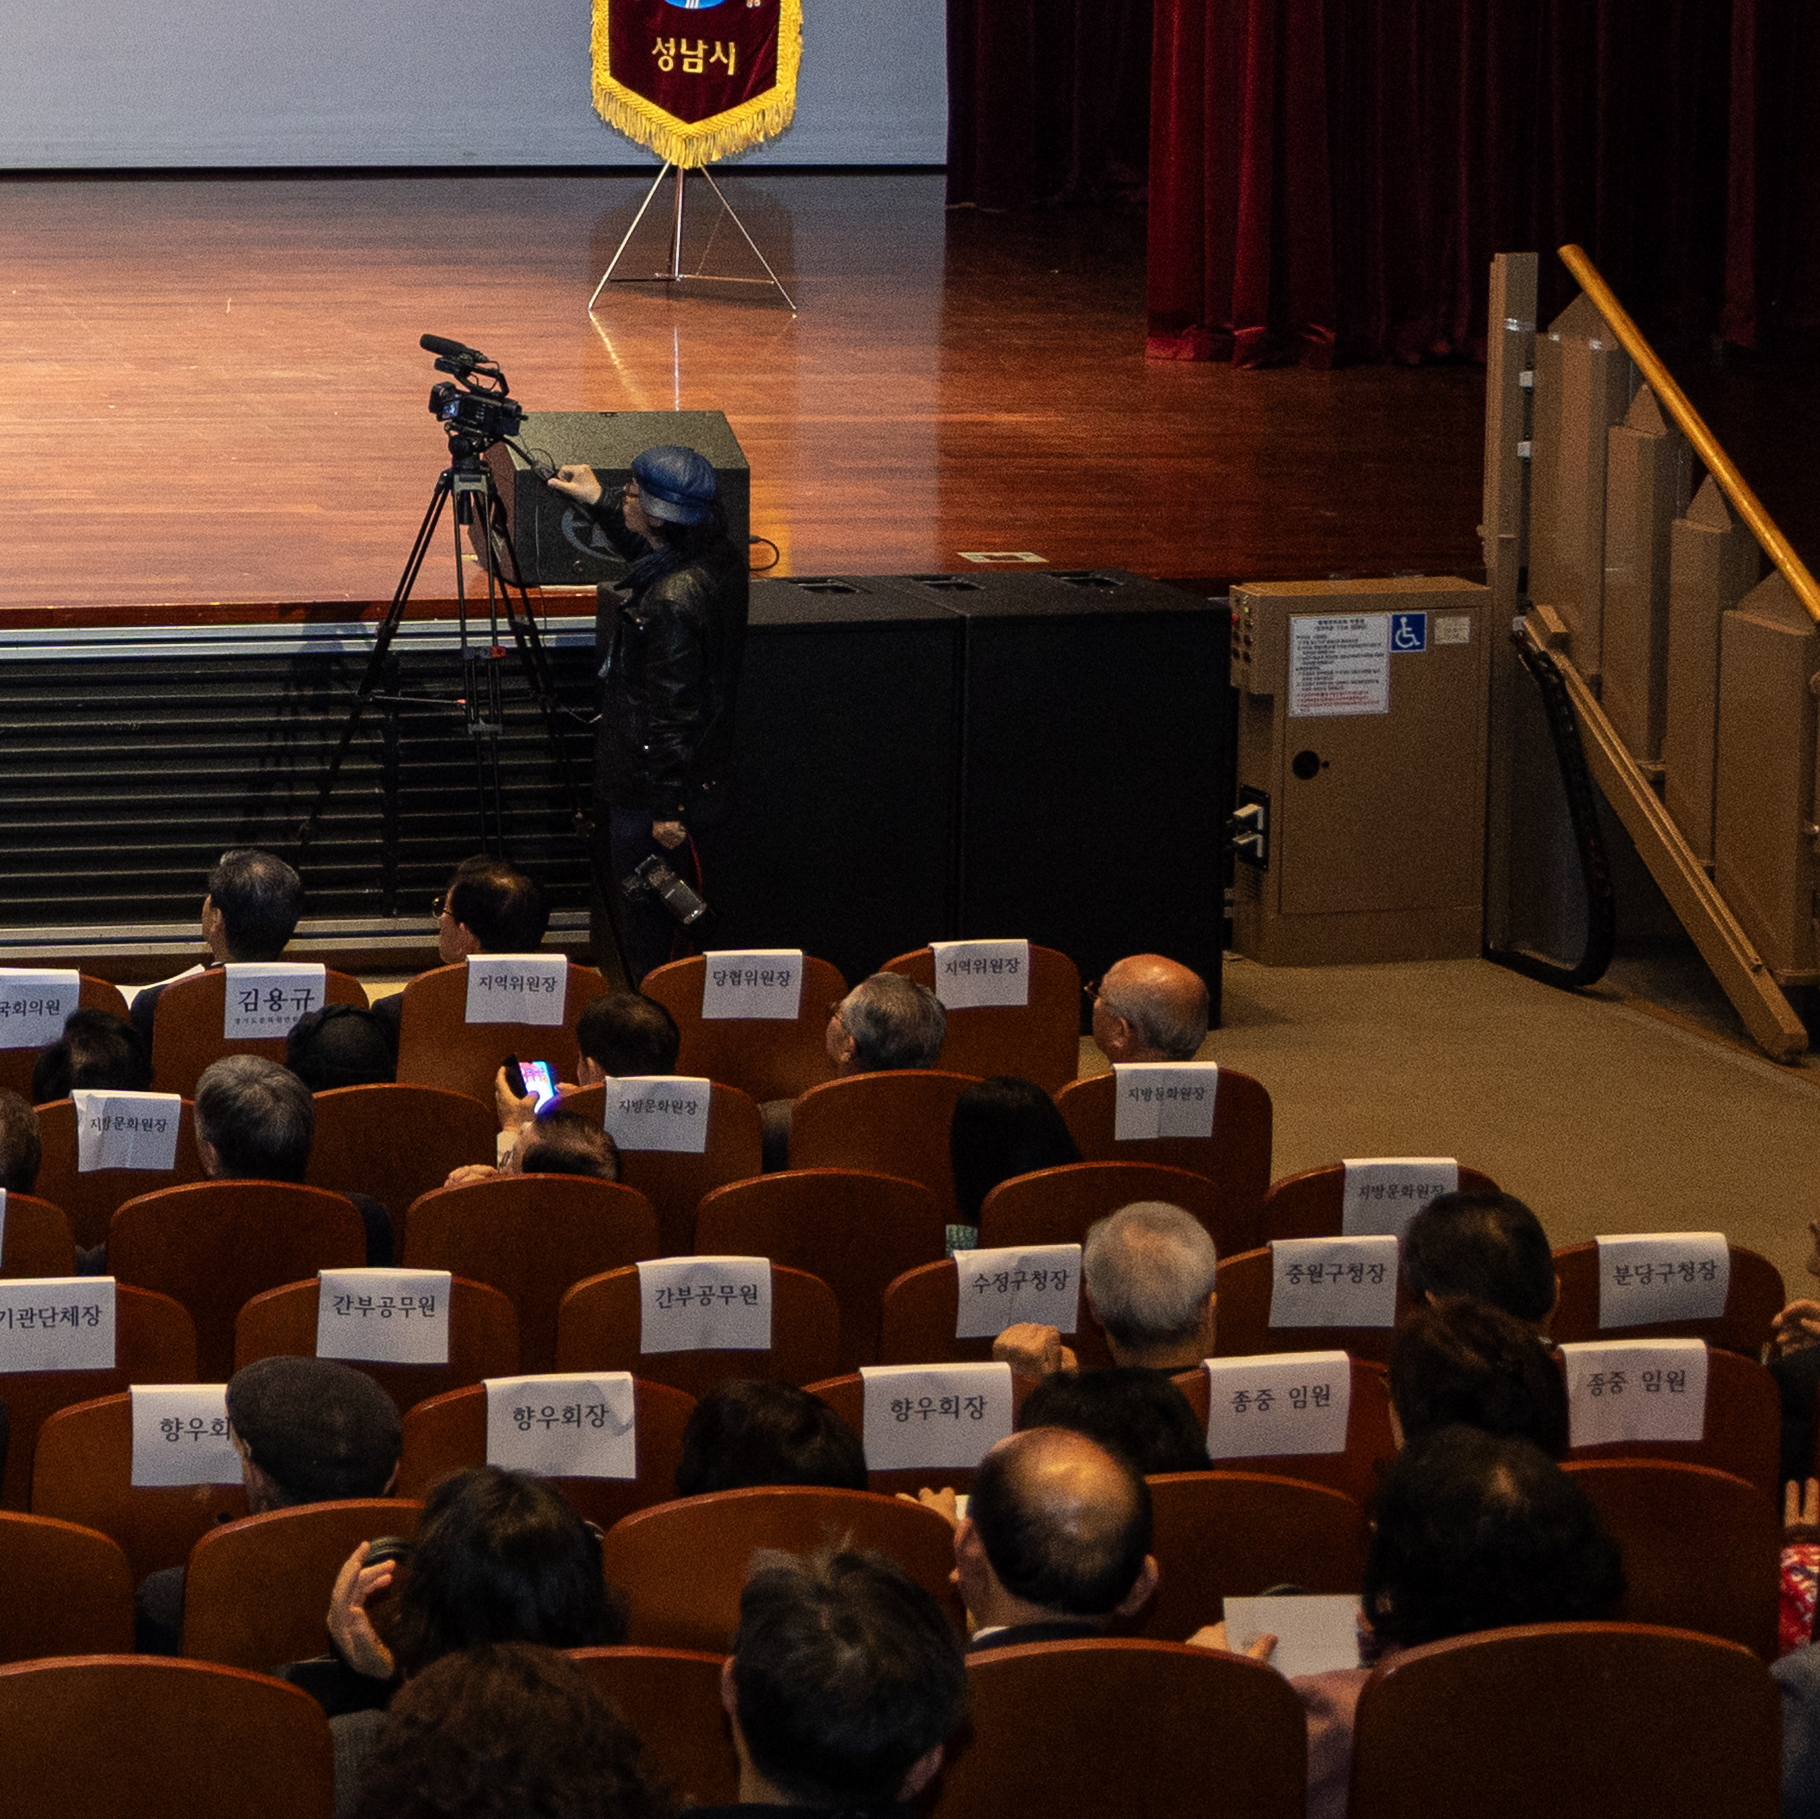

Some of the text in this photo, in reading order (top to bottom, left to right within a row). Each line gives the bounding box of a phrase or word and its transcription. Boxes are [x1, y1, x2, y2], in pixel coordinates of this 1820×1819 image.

[651, 37, 736, 76] 성남시
[712, 970, 791, 987] 당협위원장
[944, 957, 1021, 976] 지역위원장
[479, 975, 558, 993] 지역위원장
[238, 987, 315, 1013] 김용규
[618, 1098, 699, 1116] 지방문화원장
[90, 1116, 168, 1133] 지방문화원장
[972, 1269, 1070, 1294] 수정구청장
[1285, 1263, 1387, 1285] 중원구청장
[1612, 1259, 1718, 1286] 분당구청장
[332, 1294, 437, 1318] 간부공무원
[655, 1283, 759, 1309] 간부공무원
[1587, 1369, 1687, 1397] 종중 임원
[890, 1395, 988, 1423] 향우회장
[1230, 1384, 1331, 1413] 종중 임원
[512, 1403, 609, 1431] 향우회장
